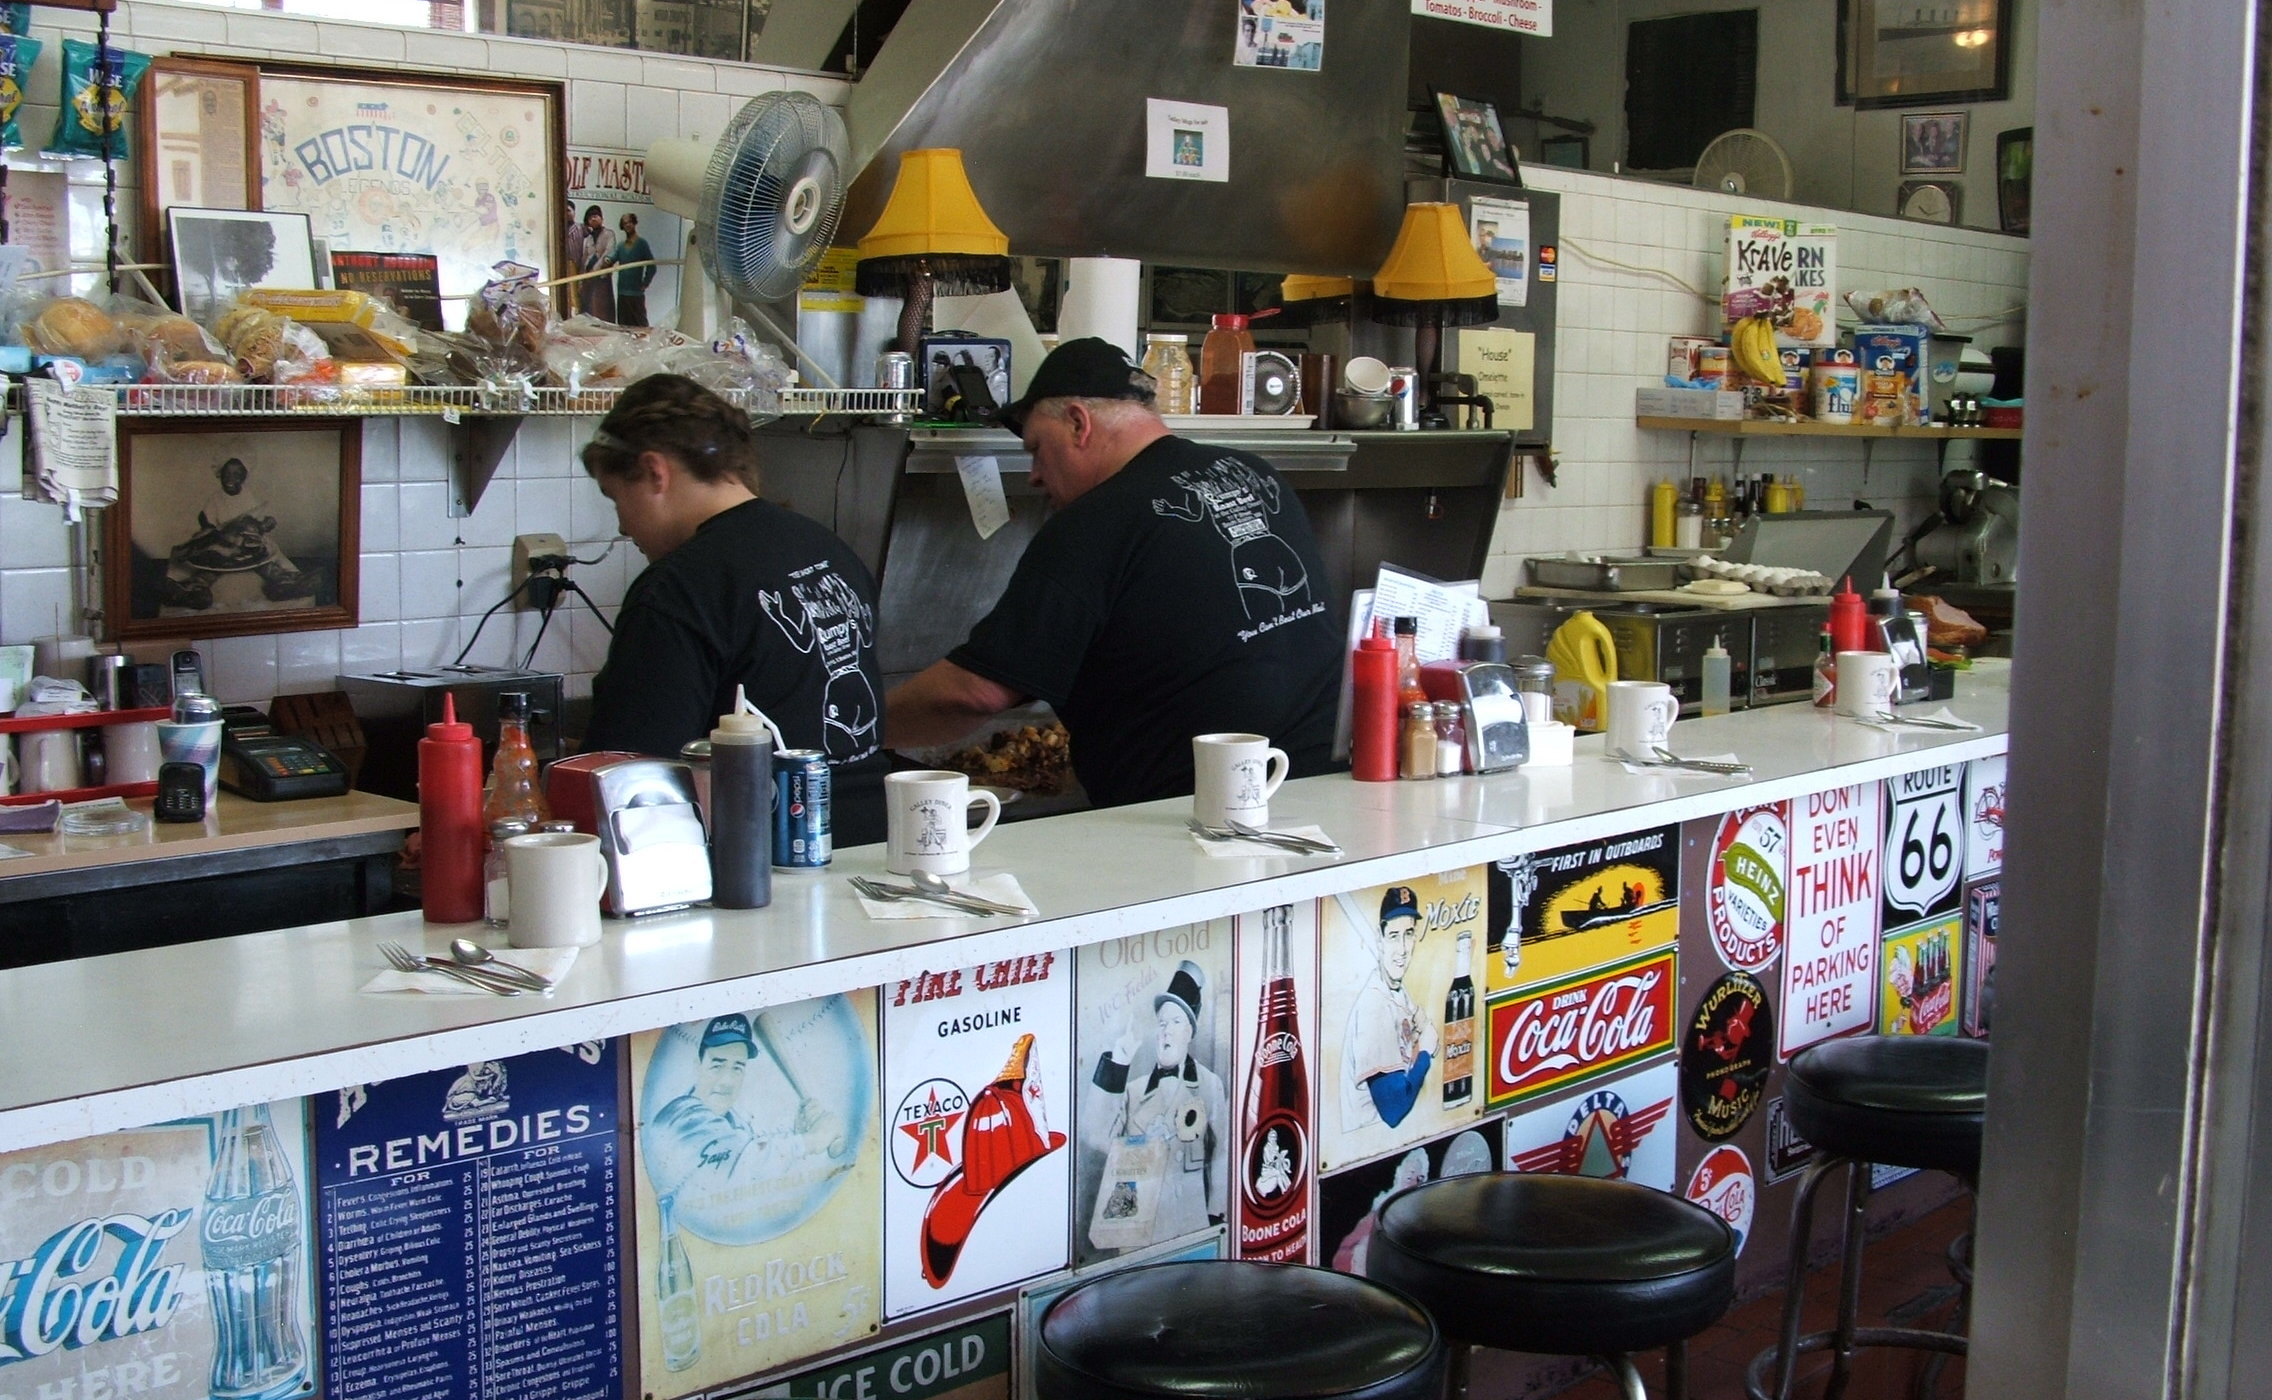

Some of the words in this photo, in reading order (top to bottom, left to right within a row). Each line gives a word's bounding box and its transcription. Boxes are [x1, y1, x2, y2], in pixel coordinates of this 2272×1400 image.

[1425, 0, 1462, 17] Tomatos
[1468, 7, 1502, 24] Broccoli
[1508, 14, 1537, 31] Cheese
[0, 62, 17, 76] SE
[89, 68, 123, 87] WSE
[294, 125, 449, 190] BOSTON
[1797, 247, 1824, 268] RN
[1904, 765, 1952, 794] ROUTE
[1551, 851, 1586, 873] FIRST
[1588, 848, 1603, 866] IN
[1605, 833, 1665, 861] OUTBOARDS
[1759, 826, 1782, 853] 57
[1814, 816, 1858, 853] EVEN
[1900, 801, 1953, 889] 66
[1400, 887, 1411, 904] B
[1736, 856, 1780, 906] HEINZ
[1796, 849, 1872, 918] THINK
[1713, 886, 1777, 963] PRODUCTS
[1728, 889, 1768, 932] VARIETIES
[1100, 935, 1145, 969] Old
[1153, 920, 1210, 959] Gold
[1821, 916, 1846, 948] OF
[893, 968, 962, 1007] FIRE
[974, 952, 1055, 992] CHIEF
[1792, 943, 1869, 994] PARKING
[1552, 989, 1588, 1010] DRINK
[1695, 972, 1763, 1031] WURLITZER
[1806, 983, 1852, 1024] HERE
[937, 1007, 1022, 1037] GASOLINE
[1500, 970, 1662, 1084] Coca-Cola
[1706, 1060, 1751, 1080] PHONOGRAPH
[904, 1096, 963, 1121] TEXACO
[1567, 1093, 1625, 1135] DELTA
[1708, 1089, 1750, 1119] MUSIC
[350, 1105, 590, 1176] REMEDIES
[523, 1145, 560, 1159] FOR
[698, 1140, 731, 1169] Says
[918, 1118, 946, 1155] T
[0, 1155, 156, 1199] COLD
[391, 1171, 430, 1186] FOR
[205, 1190, 297, 1242] Coca-Cola
[1242, 1221, 1280, 1242] BOONE
[1282, 1208, 1306, 1231] COLA
[1271, 1249, 1284, 1262] TO
[0, 1208, 193, 1355] -Cola
[737, 1301, 811, 1347] COLA
[38, 1353, 181, 1400] HERE
[816, 1366, 876, 1400] ICE
[889, 1334, 986, 1394] COLD
